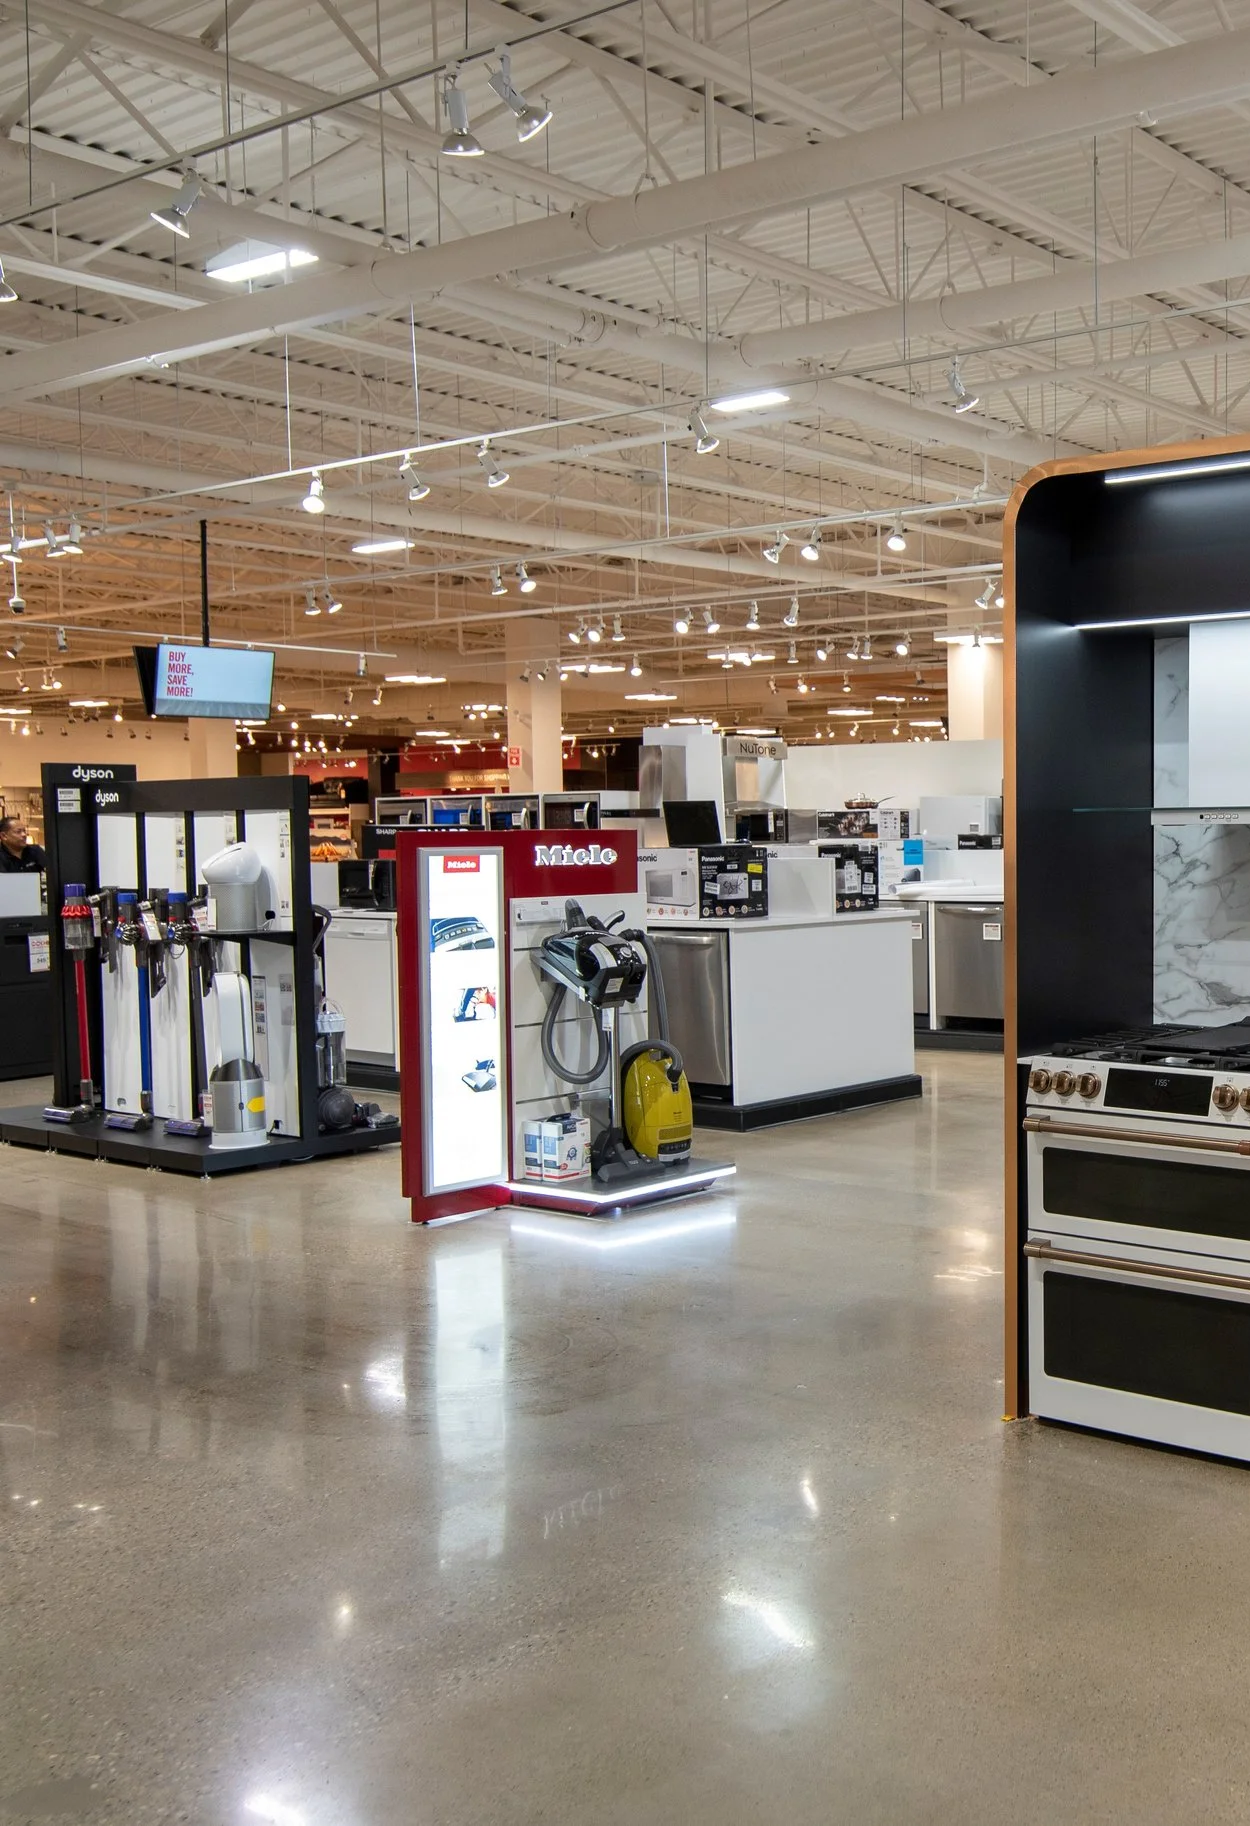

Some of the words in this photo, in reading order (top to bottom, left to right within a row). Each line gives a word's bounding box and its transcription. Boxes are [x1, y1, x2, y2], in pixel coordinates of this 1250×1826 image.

[168, 651, 186, 662] BUY
[168, 663, 194, 676] MORE,
[167, 675, 188, 686] SAVE
[166, 686, 194, 698] MORE!
[740, 743, 777, 756] NuTone
[72, 765, 114, 782] dyson
[95, 789, 120, 807] dyson
[534, 844, 619, 867] Miele
[447, 861, 477, 869] Miele
